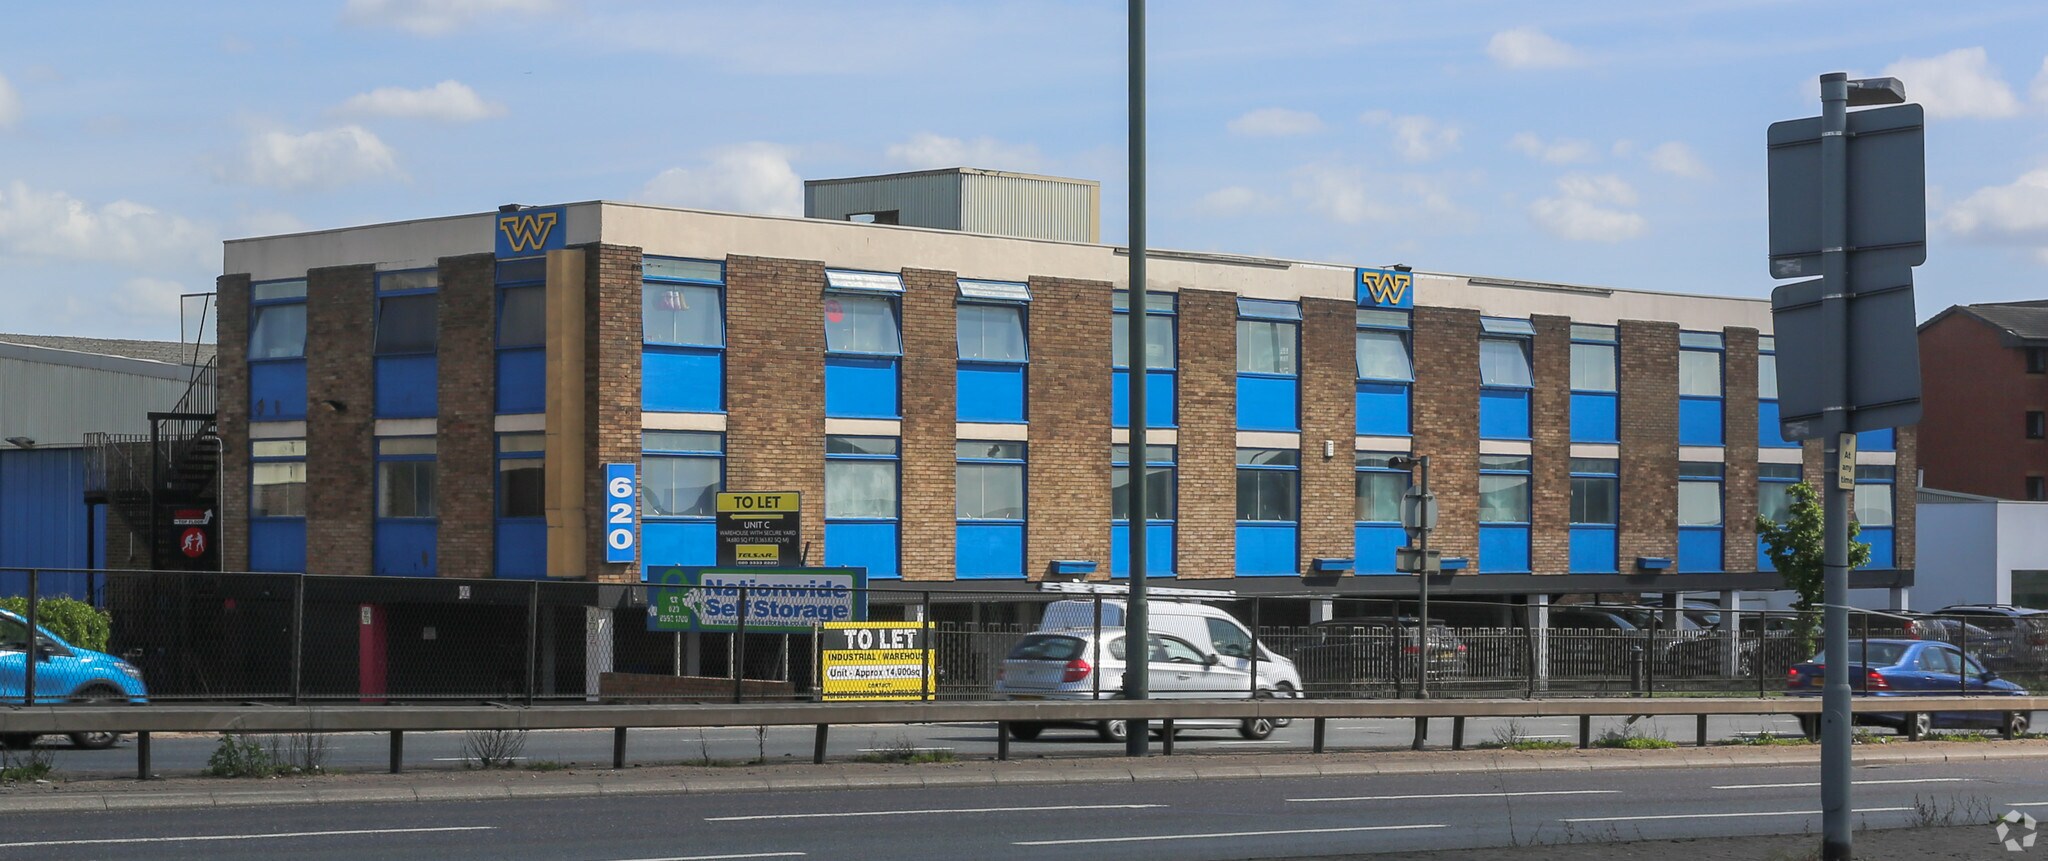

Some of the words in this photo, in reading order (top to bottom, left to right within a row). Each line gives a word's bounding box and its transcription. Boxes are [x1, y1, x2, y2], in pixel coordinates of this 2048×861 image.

[500, 212, 557, 252] W
[1363, 272, 1410, 304] W
[1844, 451, 1851, 459] At
[1842, 464, 1852, 472] any
[1841, 476, 1853, 484] time
[734, 496, 753, 508] TO
[757, 496, 781, 508] LET
[609, 477, 633, 550] 620
[744, 521, 762, 529] UNIT
[764, 521, 770, 529] C
[754, 600, 848, 621] Storage
[843, 629, 873, 649] TO
[879, 629, 917, 649] LET
[828, 653, 876, 661] INDUSTRIAL
[830, 669, 847, 677] Unit
[855, 669, 883, 678] Approx
